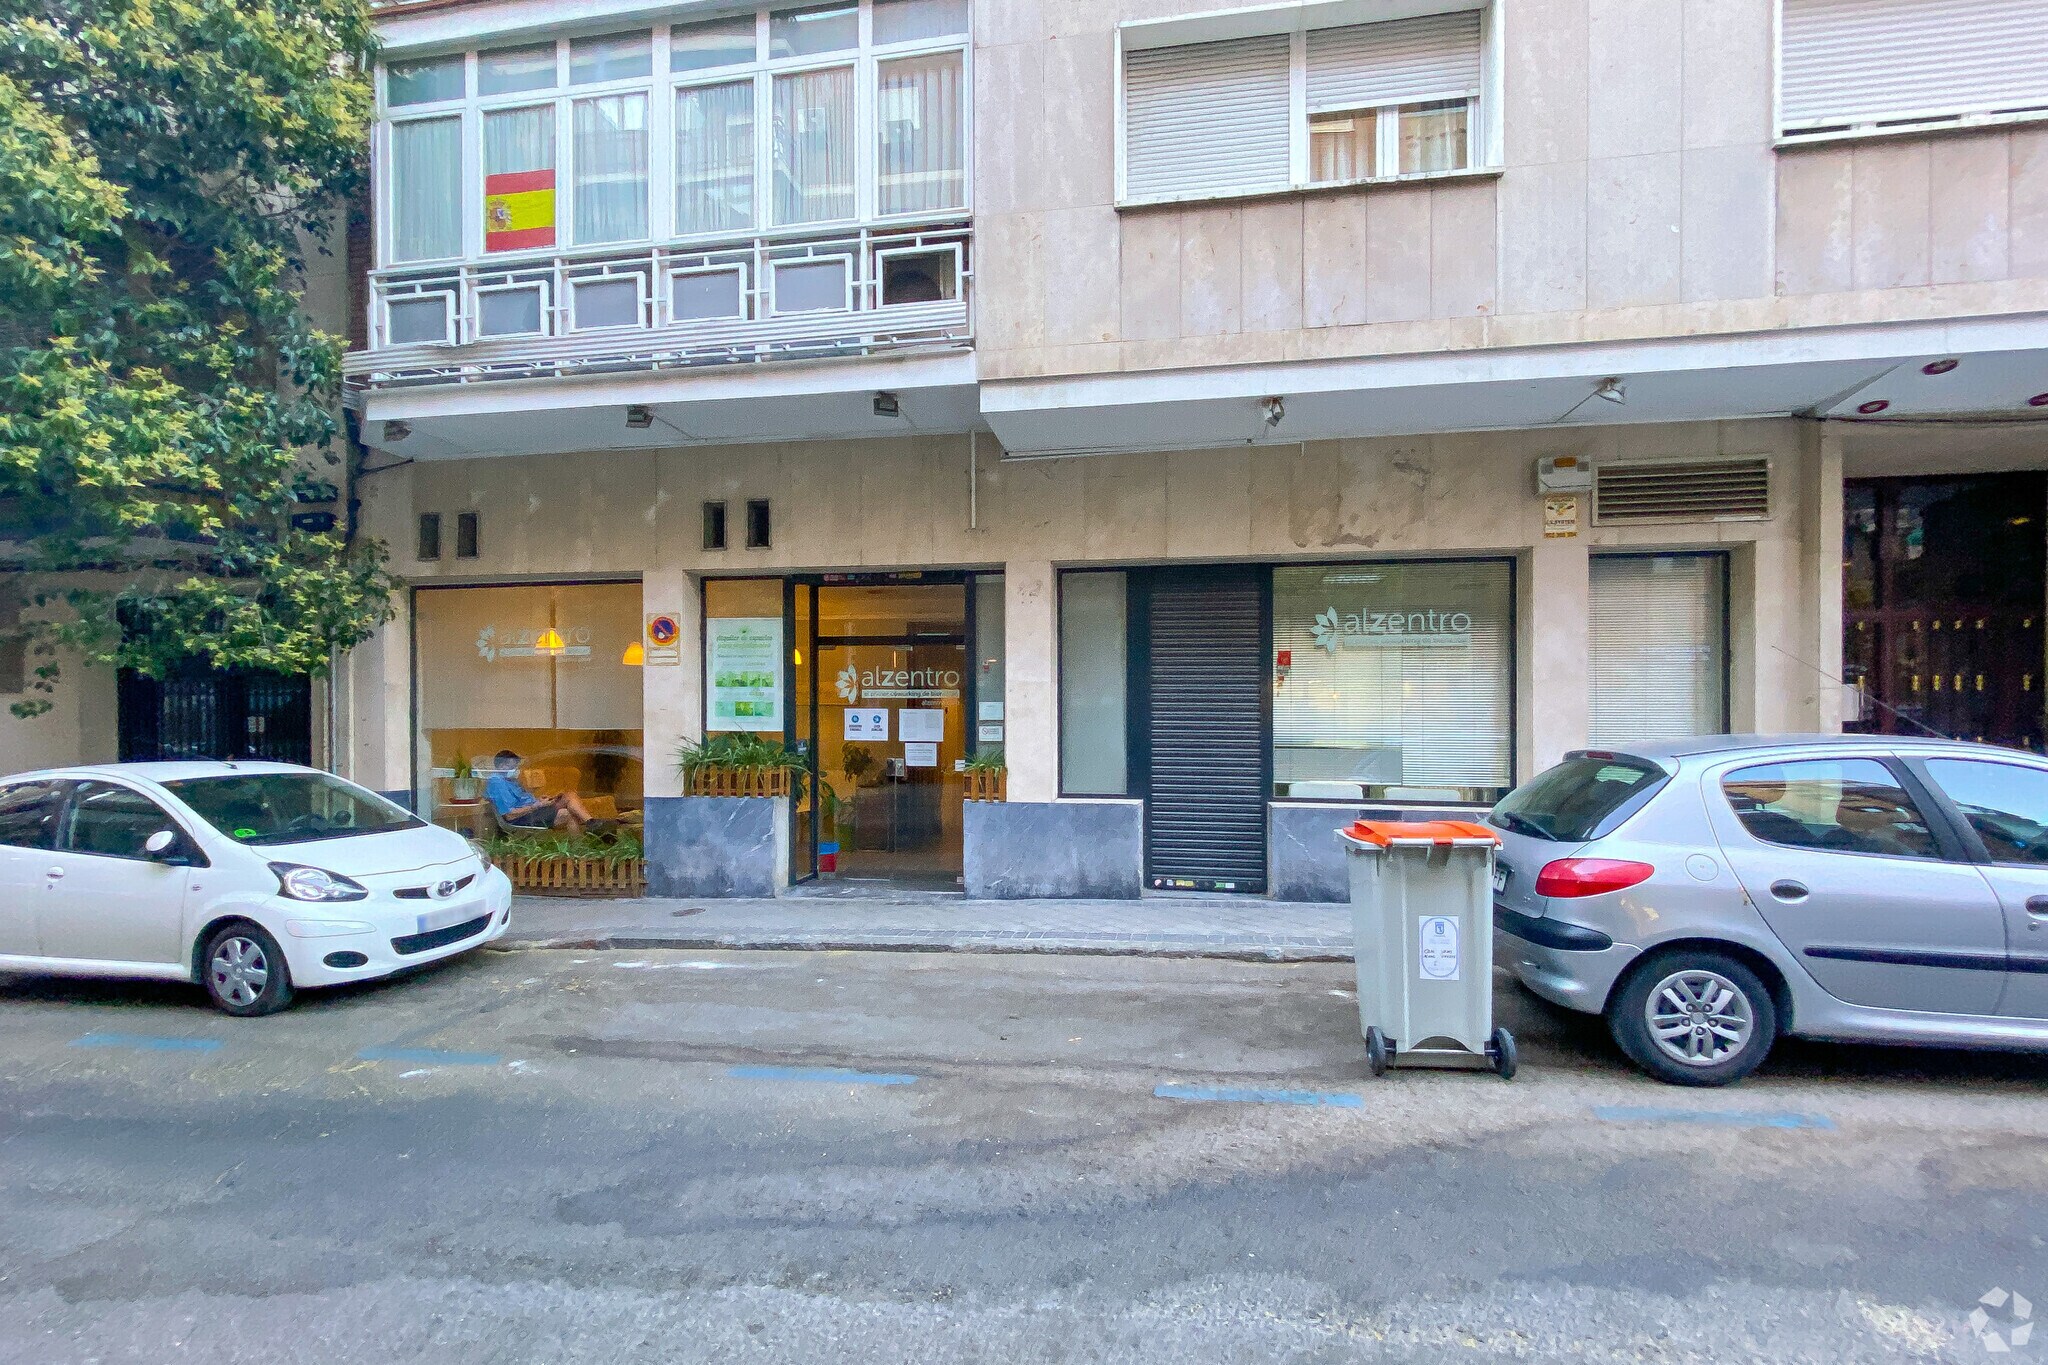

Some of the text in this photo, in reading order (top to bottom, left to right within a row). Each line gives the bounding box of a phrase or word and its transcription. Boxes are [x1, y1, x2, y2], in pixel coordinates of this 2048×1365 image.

[1344, 608, 1471, 632] alzentro
[498, 626, 592, 645] azenro
[861, 665, 960, 687] alzentro
[889, 690, 922, 698] coworking
